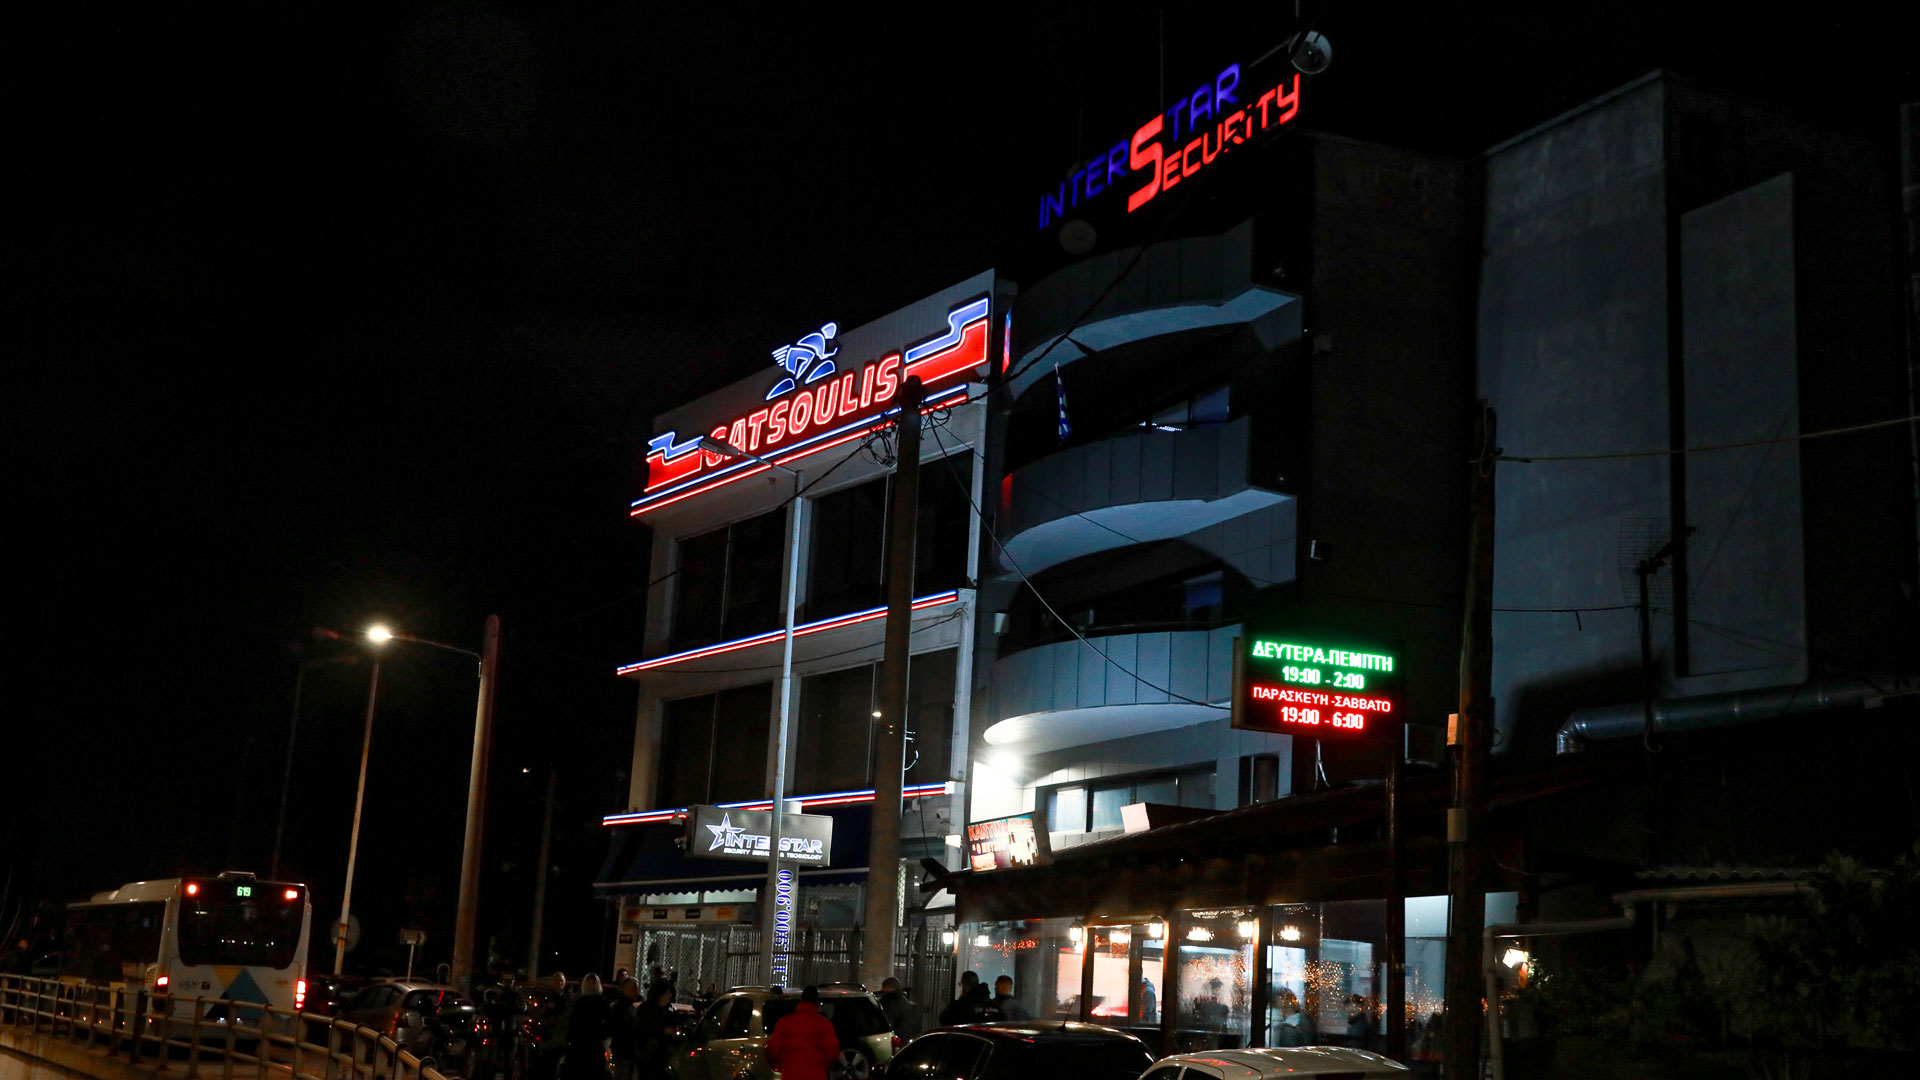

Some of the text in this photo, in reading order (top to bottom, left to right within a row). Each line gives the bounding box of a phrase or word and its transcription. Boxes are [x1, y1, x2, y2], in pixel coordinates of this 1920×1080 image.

[1282, 666, 1321, 684] 19:00
[1333, 671, 1365, 689] 2:00
[1253, 686, 1329, 705] ΠΑΡΑΣΚΕΥΗ
[1281, 706, 1320, 724] 19:00
[1332, 711, 1364, 729] 6:00
[725, 832, 823, 854] INTESTAR
[237, 886, 251, 897] 619
